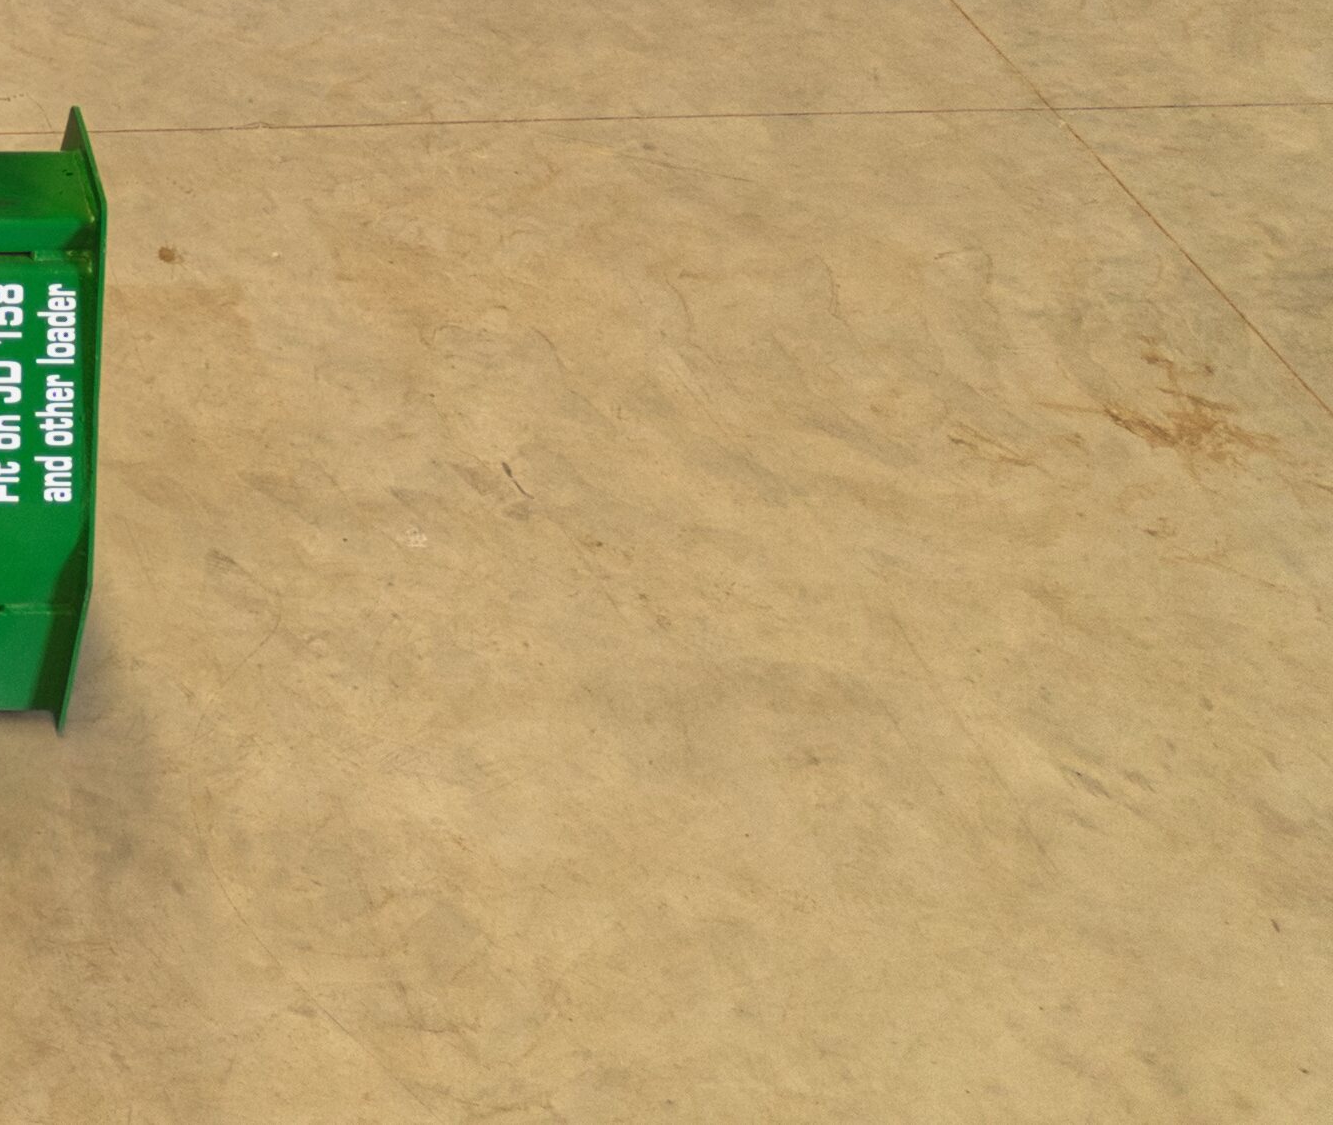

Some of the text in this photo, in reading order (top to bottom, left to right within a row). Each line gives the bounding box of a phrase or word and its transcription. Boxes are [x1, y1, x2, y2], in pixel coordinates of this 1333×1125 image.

[34, 283, 76, 502] and other loader
